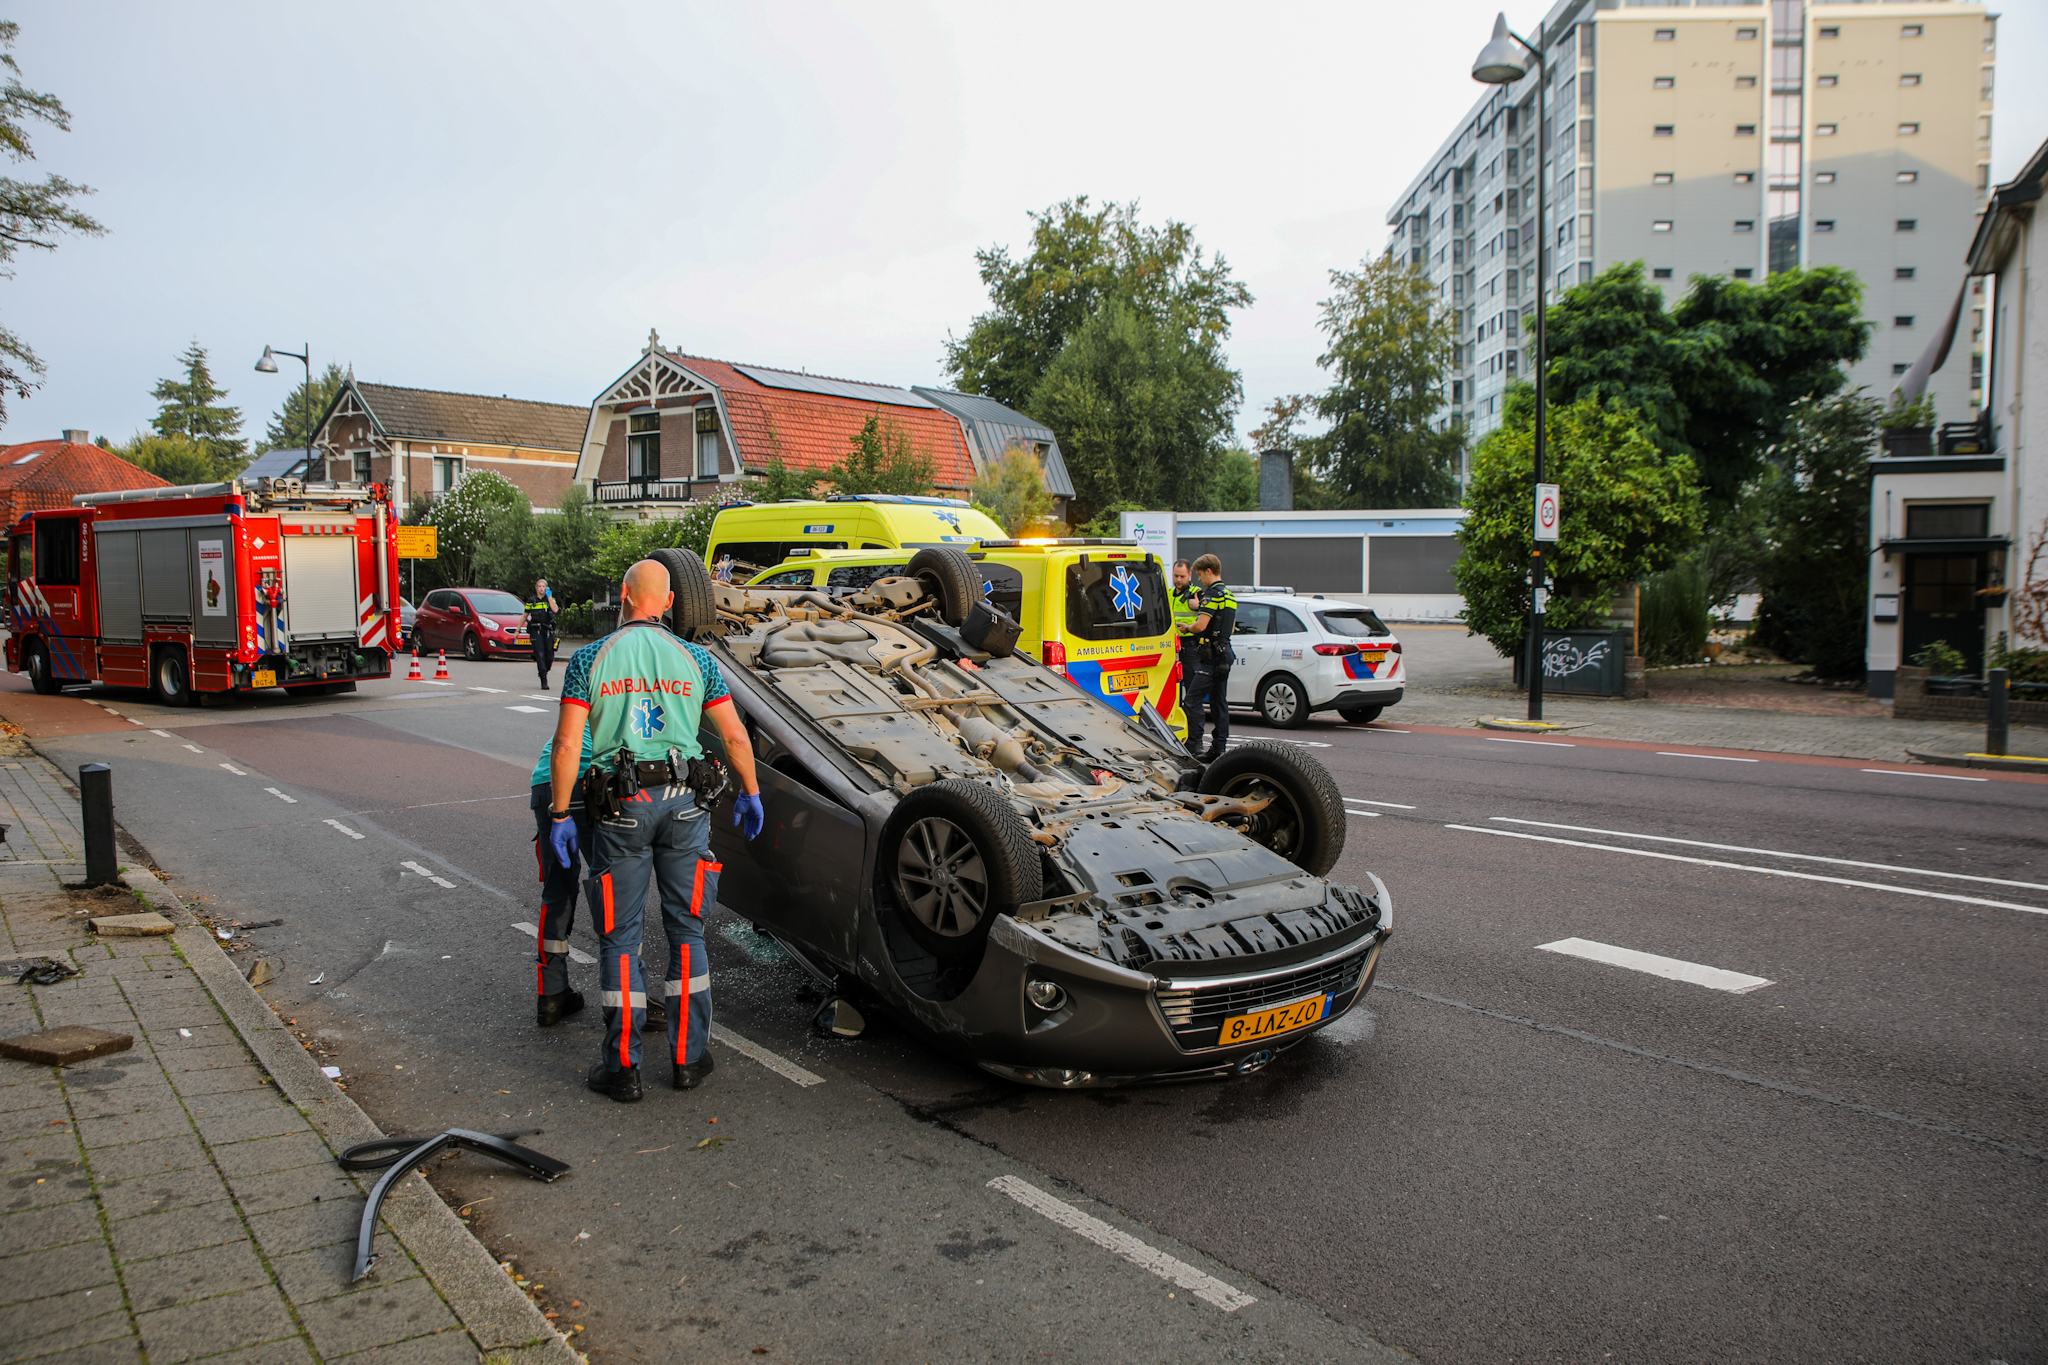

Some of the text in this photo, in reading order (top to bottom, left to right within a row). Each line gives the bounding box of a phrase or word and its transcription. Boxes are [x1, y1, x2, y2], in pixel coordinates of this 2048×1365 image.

[1544, 506, 1554, 518] 30
[1076, 645, 1123, 656] AMBULANCE
[600, 678, 693, 697] AMBULANCE
[1115, 674, 1146, 688] N-222-TJ
[1231, 1001, 1317, 1039] 07-ZVT-8
